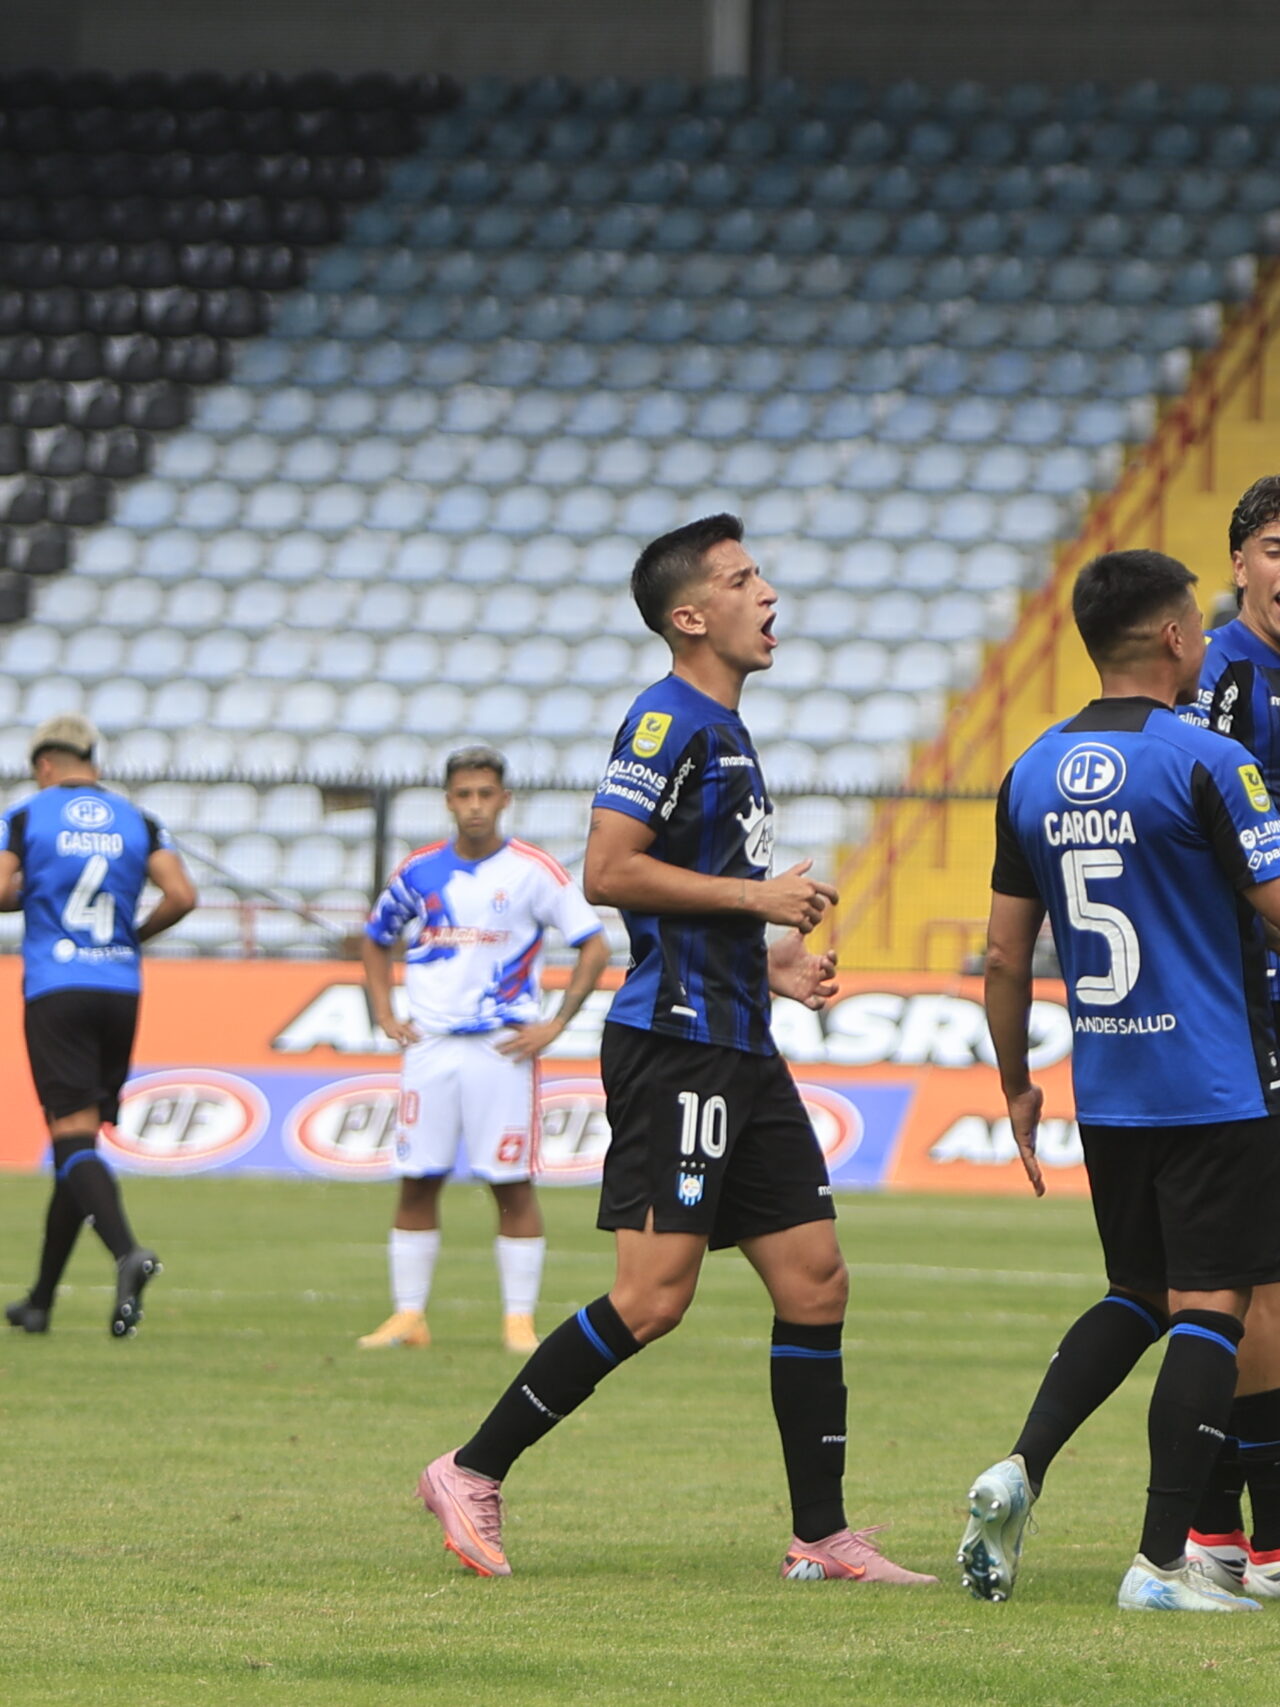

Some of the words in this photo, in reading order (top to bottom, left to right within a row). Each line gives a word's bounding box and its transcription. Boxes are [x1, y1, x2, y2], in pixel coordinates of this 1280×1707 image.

[618, 760, 668, 790] LIONS
[1069, 754, 1107, 790] PF
[605, 782, 656, 812] passline
[57, 830, 123, 857] CASTRO
[1044, 809, 1137, 846] CAROCA
[62, 853, 116, 947] 4
[1060, 849, 1141, 1006] 5
[677, 1091, 728, 1159] 10
